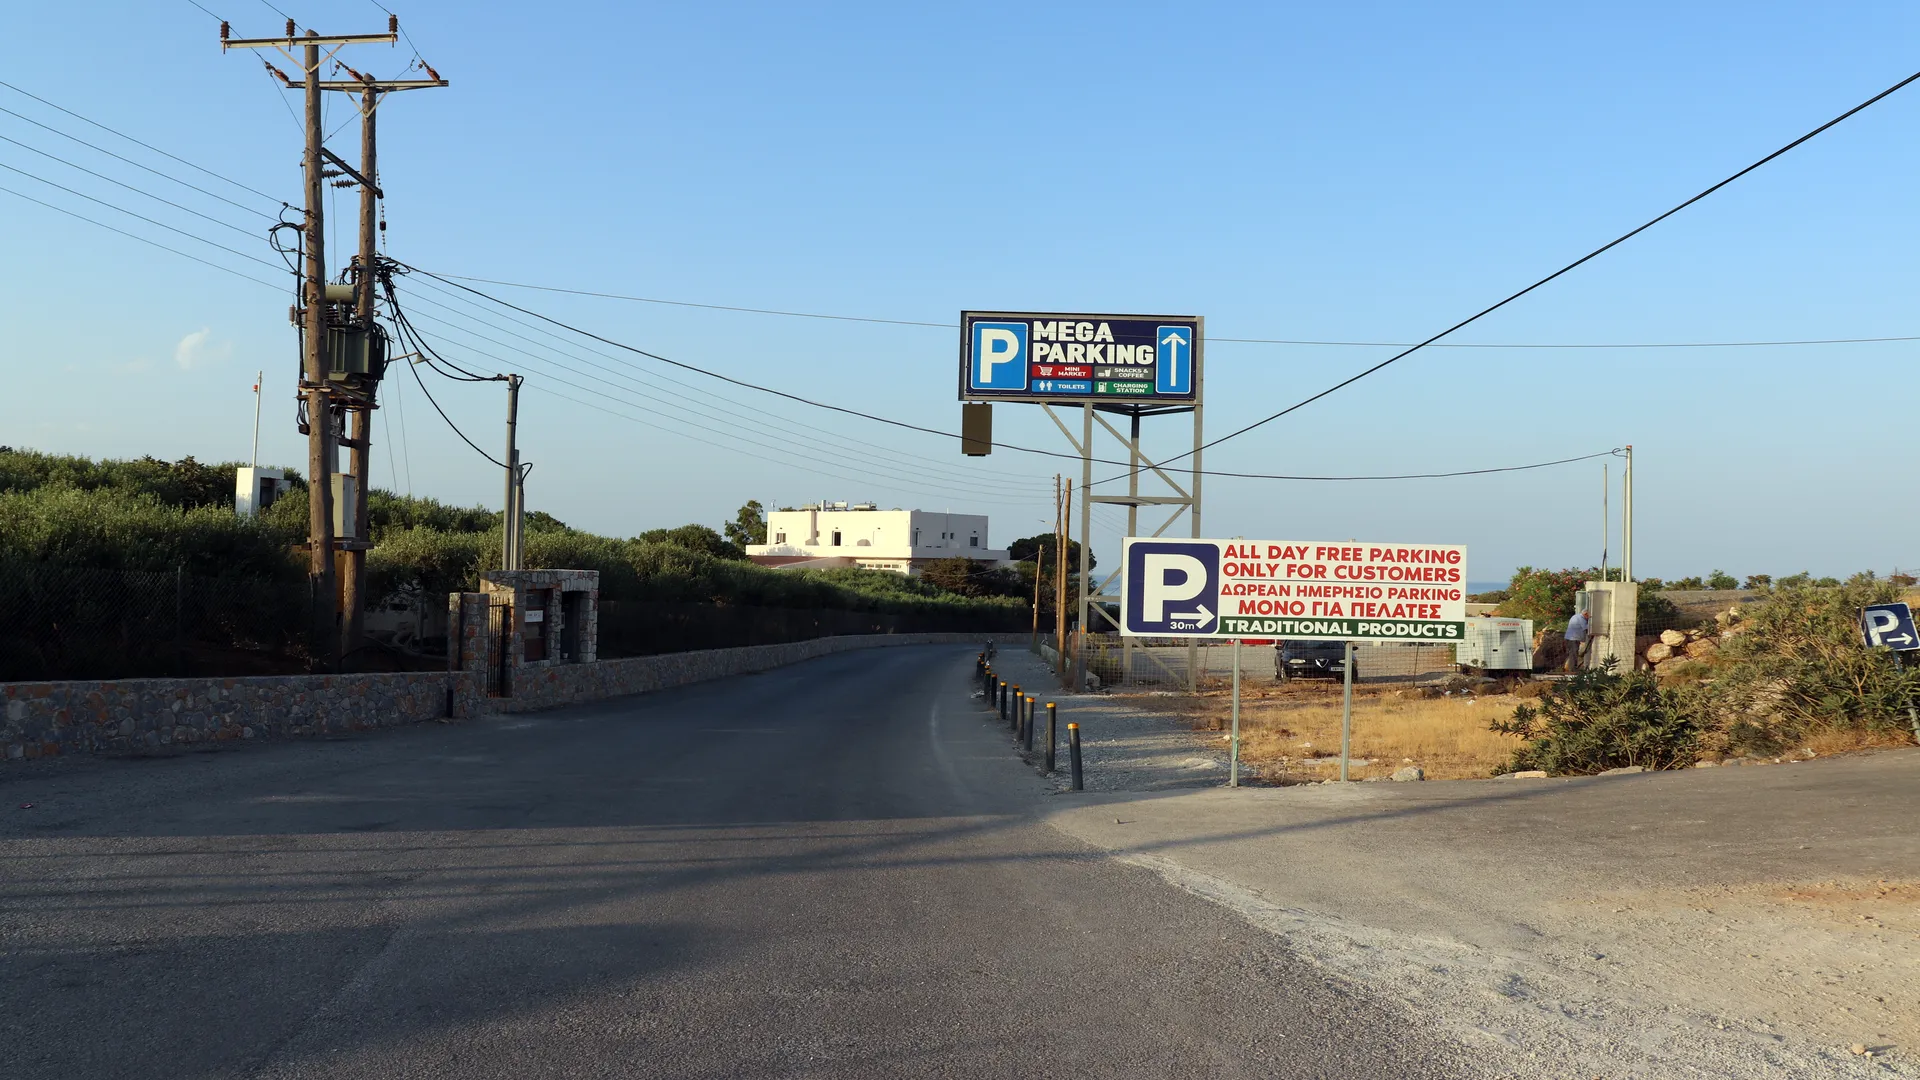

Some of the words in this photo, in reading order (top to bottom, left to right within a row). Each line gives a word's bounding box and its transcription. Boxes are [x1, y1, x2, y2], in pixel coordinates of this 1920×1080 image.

[1033, 320, 1115, 343] MEGA
[980, 328, 1019, 383] P
[1032, 342, 1154, 365] PARKING
[1223, 544, 1261, 560] ALL
[1267, 545, 1310, 560] DAY
[1316, 546, 1363, 562] FREE
[1369, 548, 1461, 565] PARKING
[1222, 562, 1280, 578] ONLY
[1286, 563, 1327, 579] FOR
[1333, 564, 1461, 583] CUSTOMERS
[1143, 553, 1208, 623] P
[1220, 583, 1291, 597] ΔΩΡΕΑΝ
[1296, 585, 1383, 599] ΗΜΕΡΗΣΙΟ
[1387, 587, 1462, 601] PARKING
[1238, 599, 1306, 616] ΜΟΝΟ
[1312, 600, 1344, 617] ΓΙΑ
[1350, 602, 1442, 619] ΠΕΛΑΤΕΣ
[1170, 621, 1195, 630] 30m
[1225, 619, 1352, 635] TRADITIONAL
[1357, 621, 1458, 637] PRODUCTS
[1864, 609, 1899, 647] P
